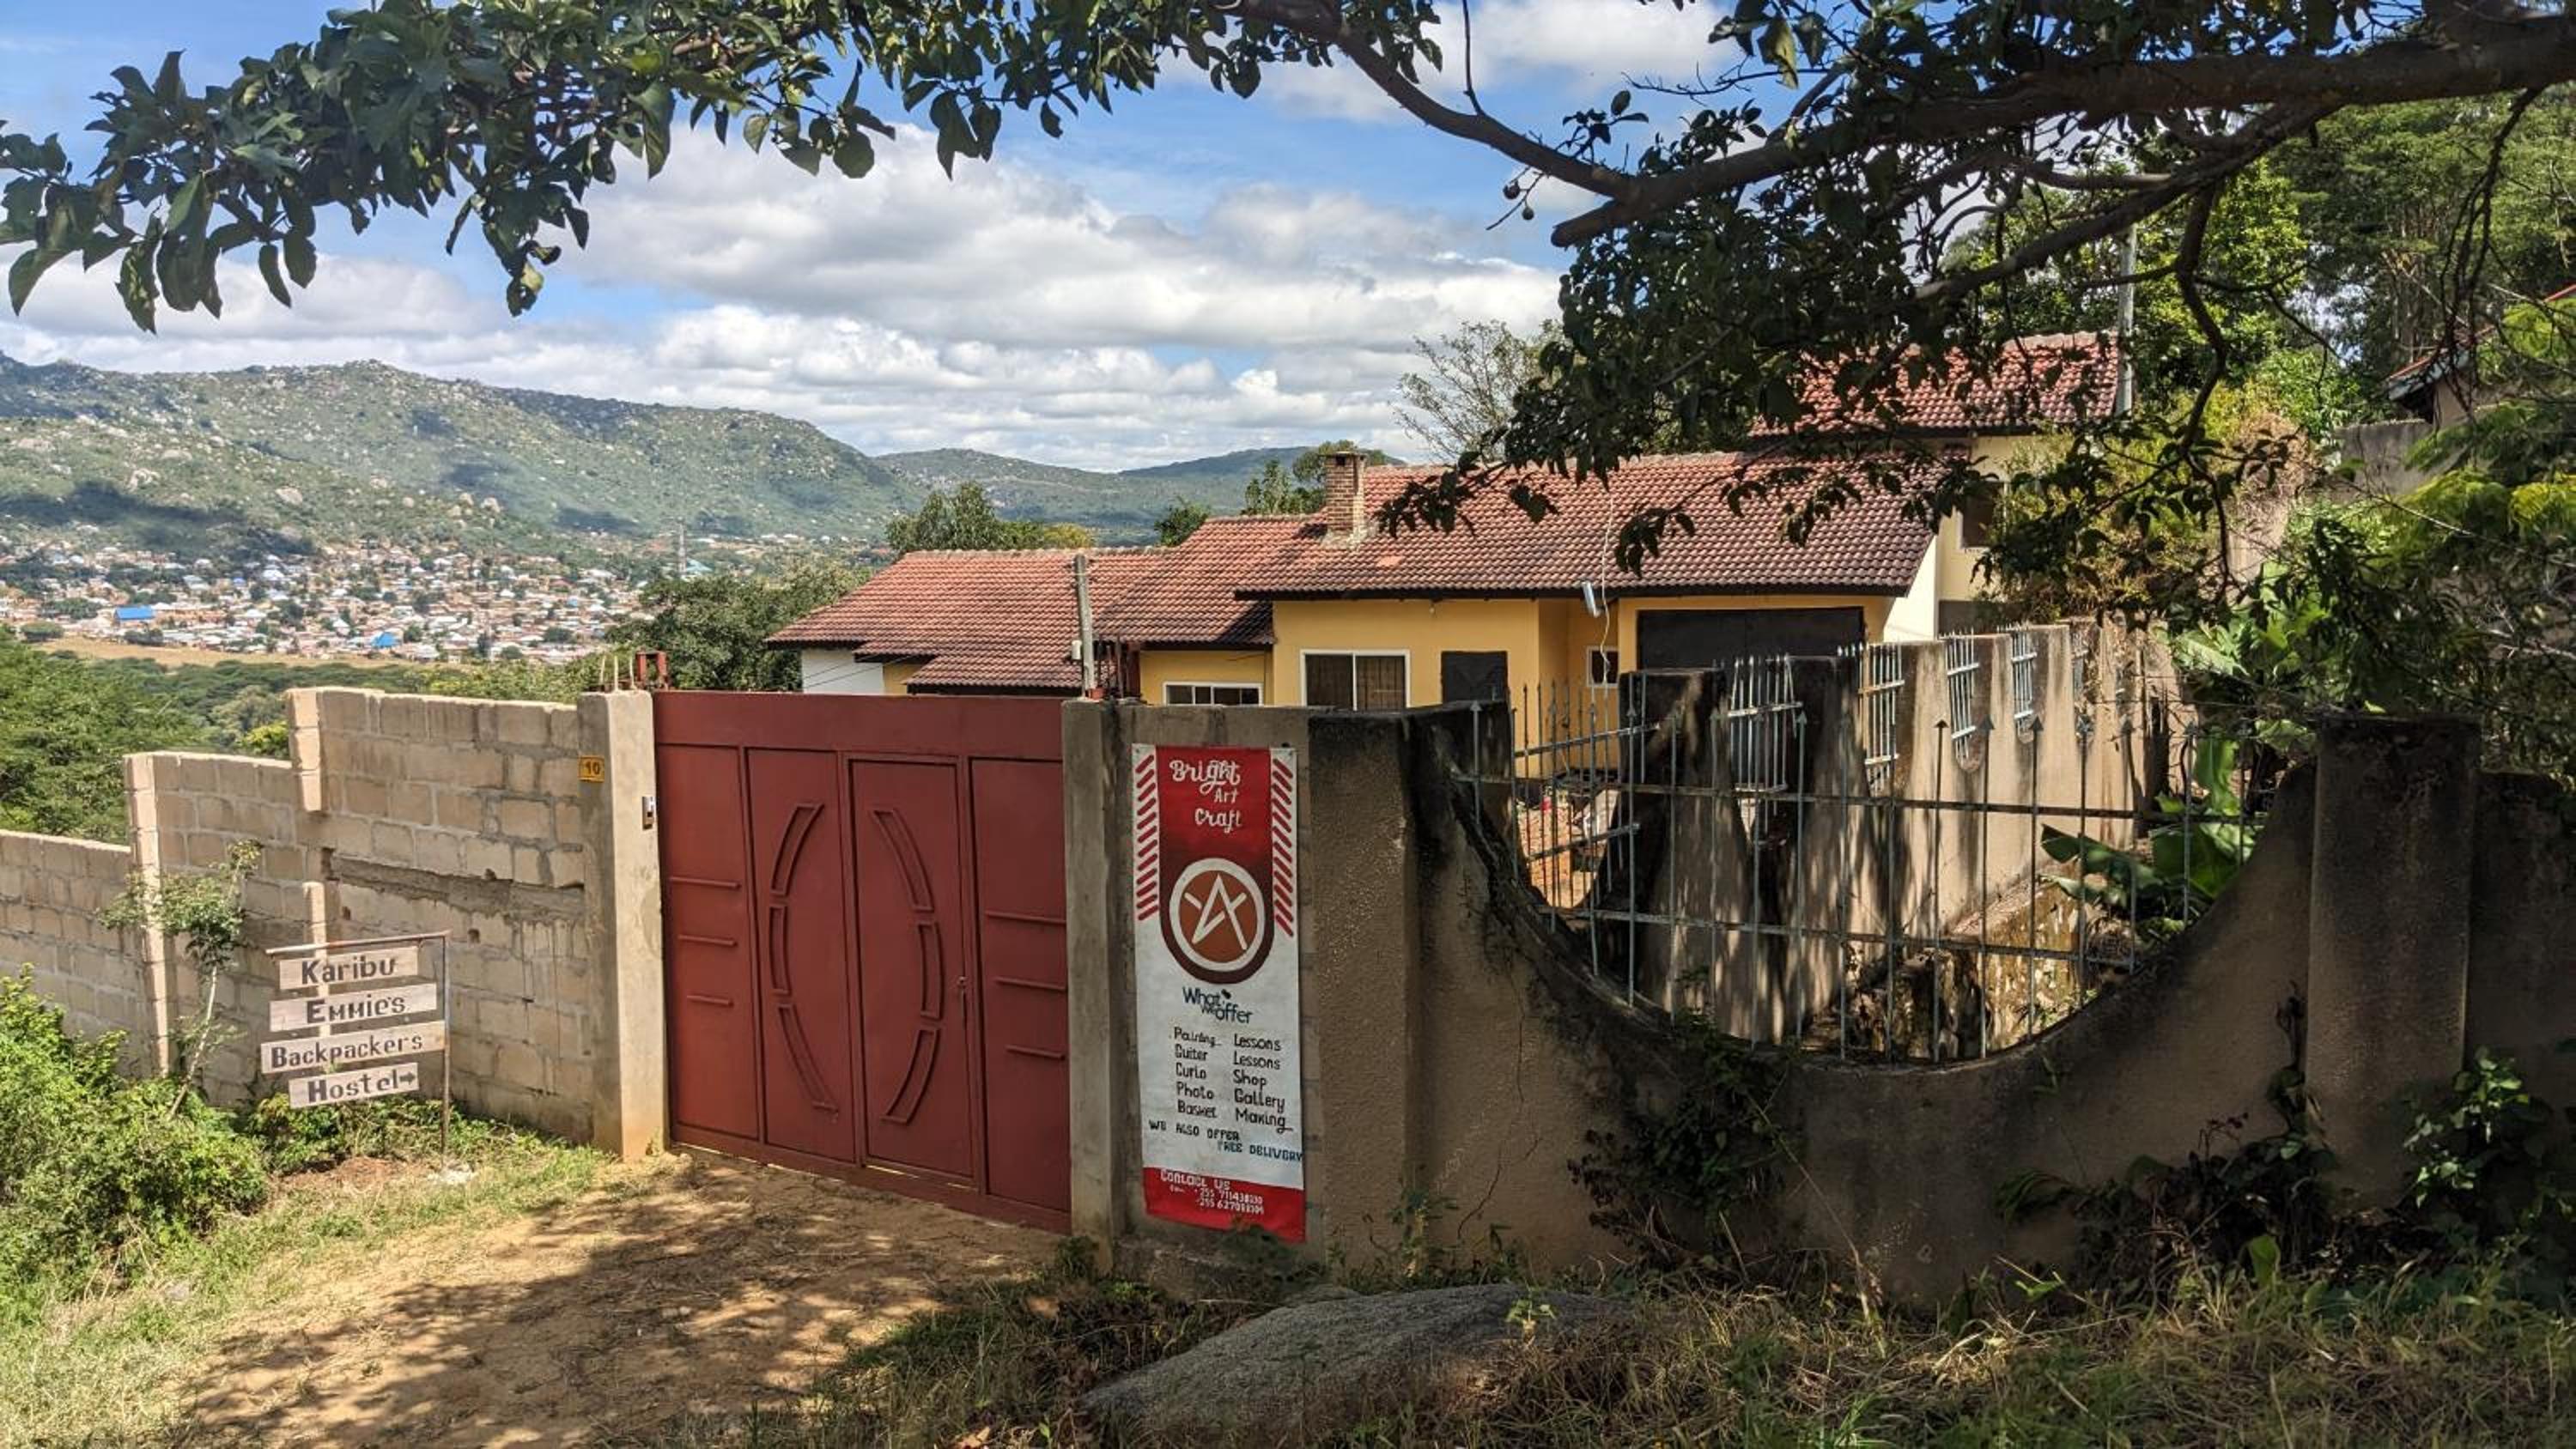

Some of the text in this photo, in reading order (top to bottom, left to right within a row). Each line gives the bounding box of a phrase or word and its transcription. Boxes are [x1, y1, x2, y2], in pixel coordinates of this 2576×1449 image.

[585, 761, 600, 775] 10
[1170, 760, 1241, 794] Bright
[1214, 789, 1239, 803] Art
[1194, 808, 1242, 833] Craft
[301, 955, 397, 985] Karibu
[1182, 987, 1222, 1005] What
[1215, 1002, 1253, 1023] offer
[271, 1034, 423, 1069] Backpackers
[1234, 1034, 1281, 1052] Lessons
[1233, 1051, 1281, 1070] Lessons
[307, 1069, 398, 1103] Hostel
[1233, 1069, 1267, 1090] Shop
[1176, 1082, 1285, 1113] Photo Gallery
[1235, 1107, 1293, 1134] Making
[1176, 1123, 1200, 1136] ALSO
[1207, 1128, 1239, 1140] OFFER
[1250, 1144, 1303, 1161] DELIVERY
